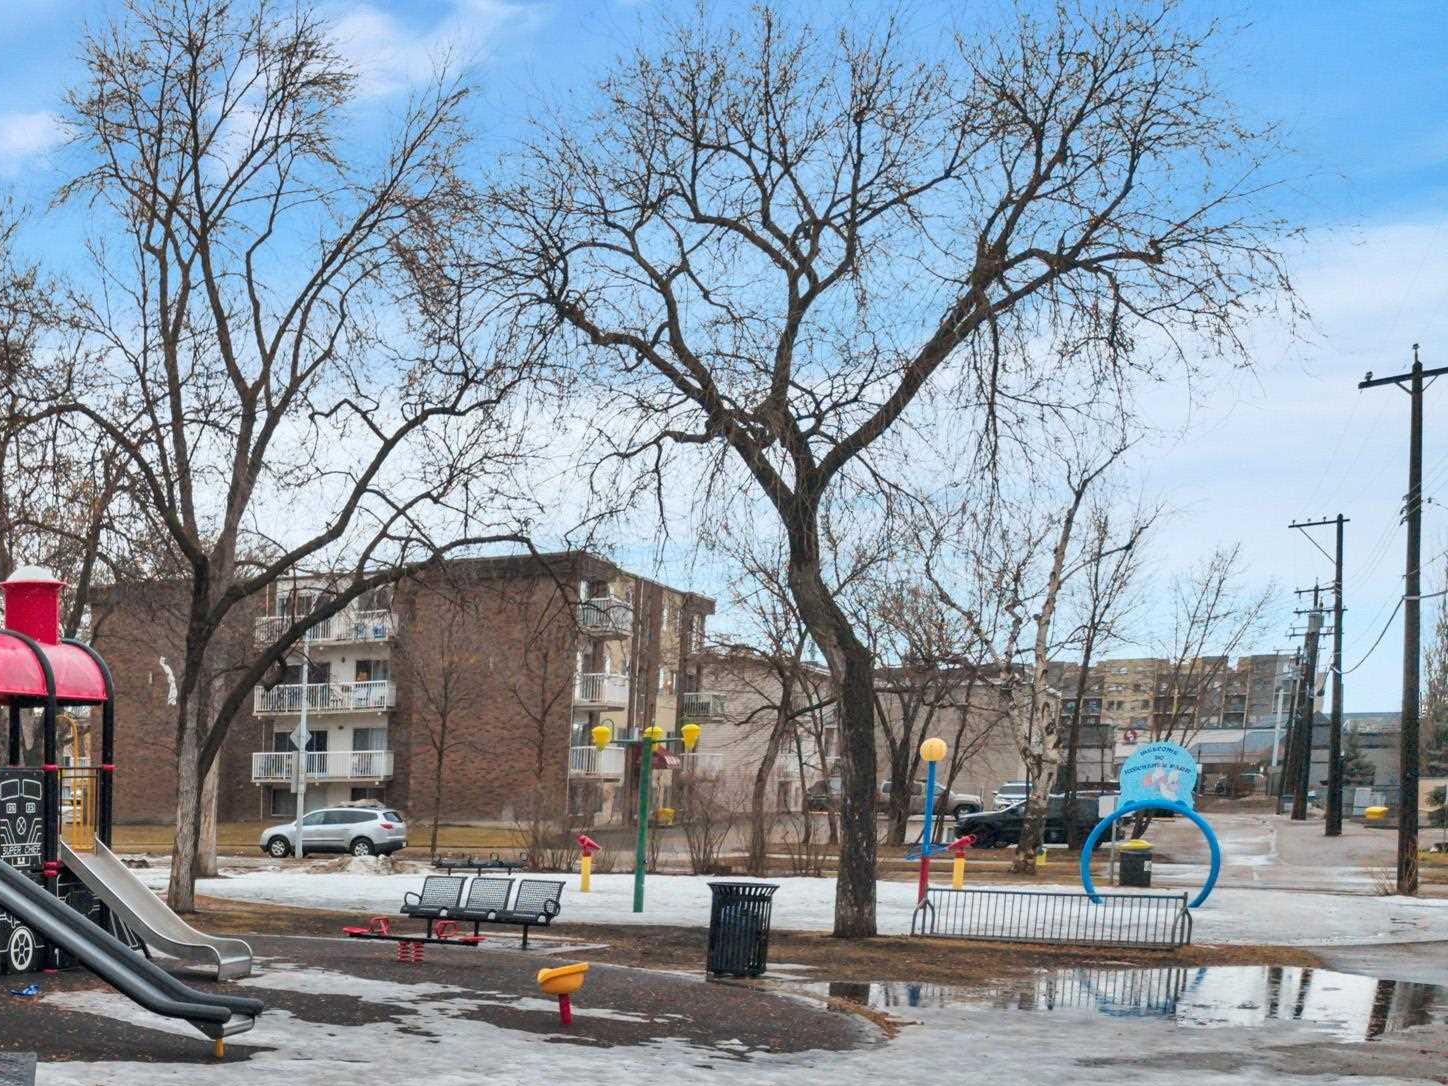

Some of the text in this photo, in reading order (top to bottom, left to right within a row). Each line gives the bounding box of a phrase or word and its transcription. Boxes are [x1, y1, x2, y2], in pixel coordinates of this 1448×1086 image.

[1140, 746, 1177, 756] WELCOME
[2, 845, 41, 855] SUPER CHIEF
